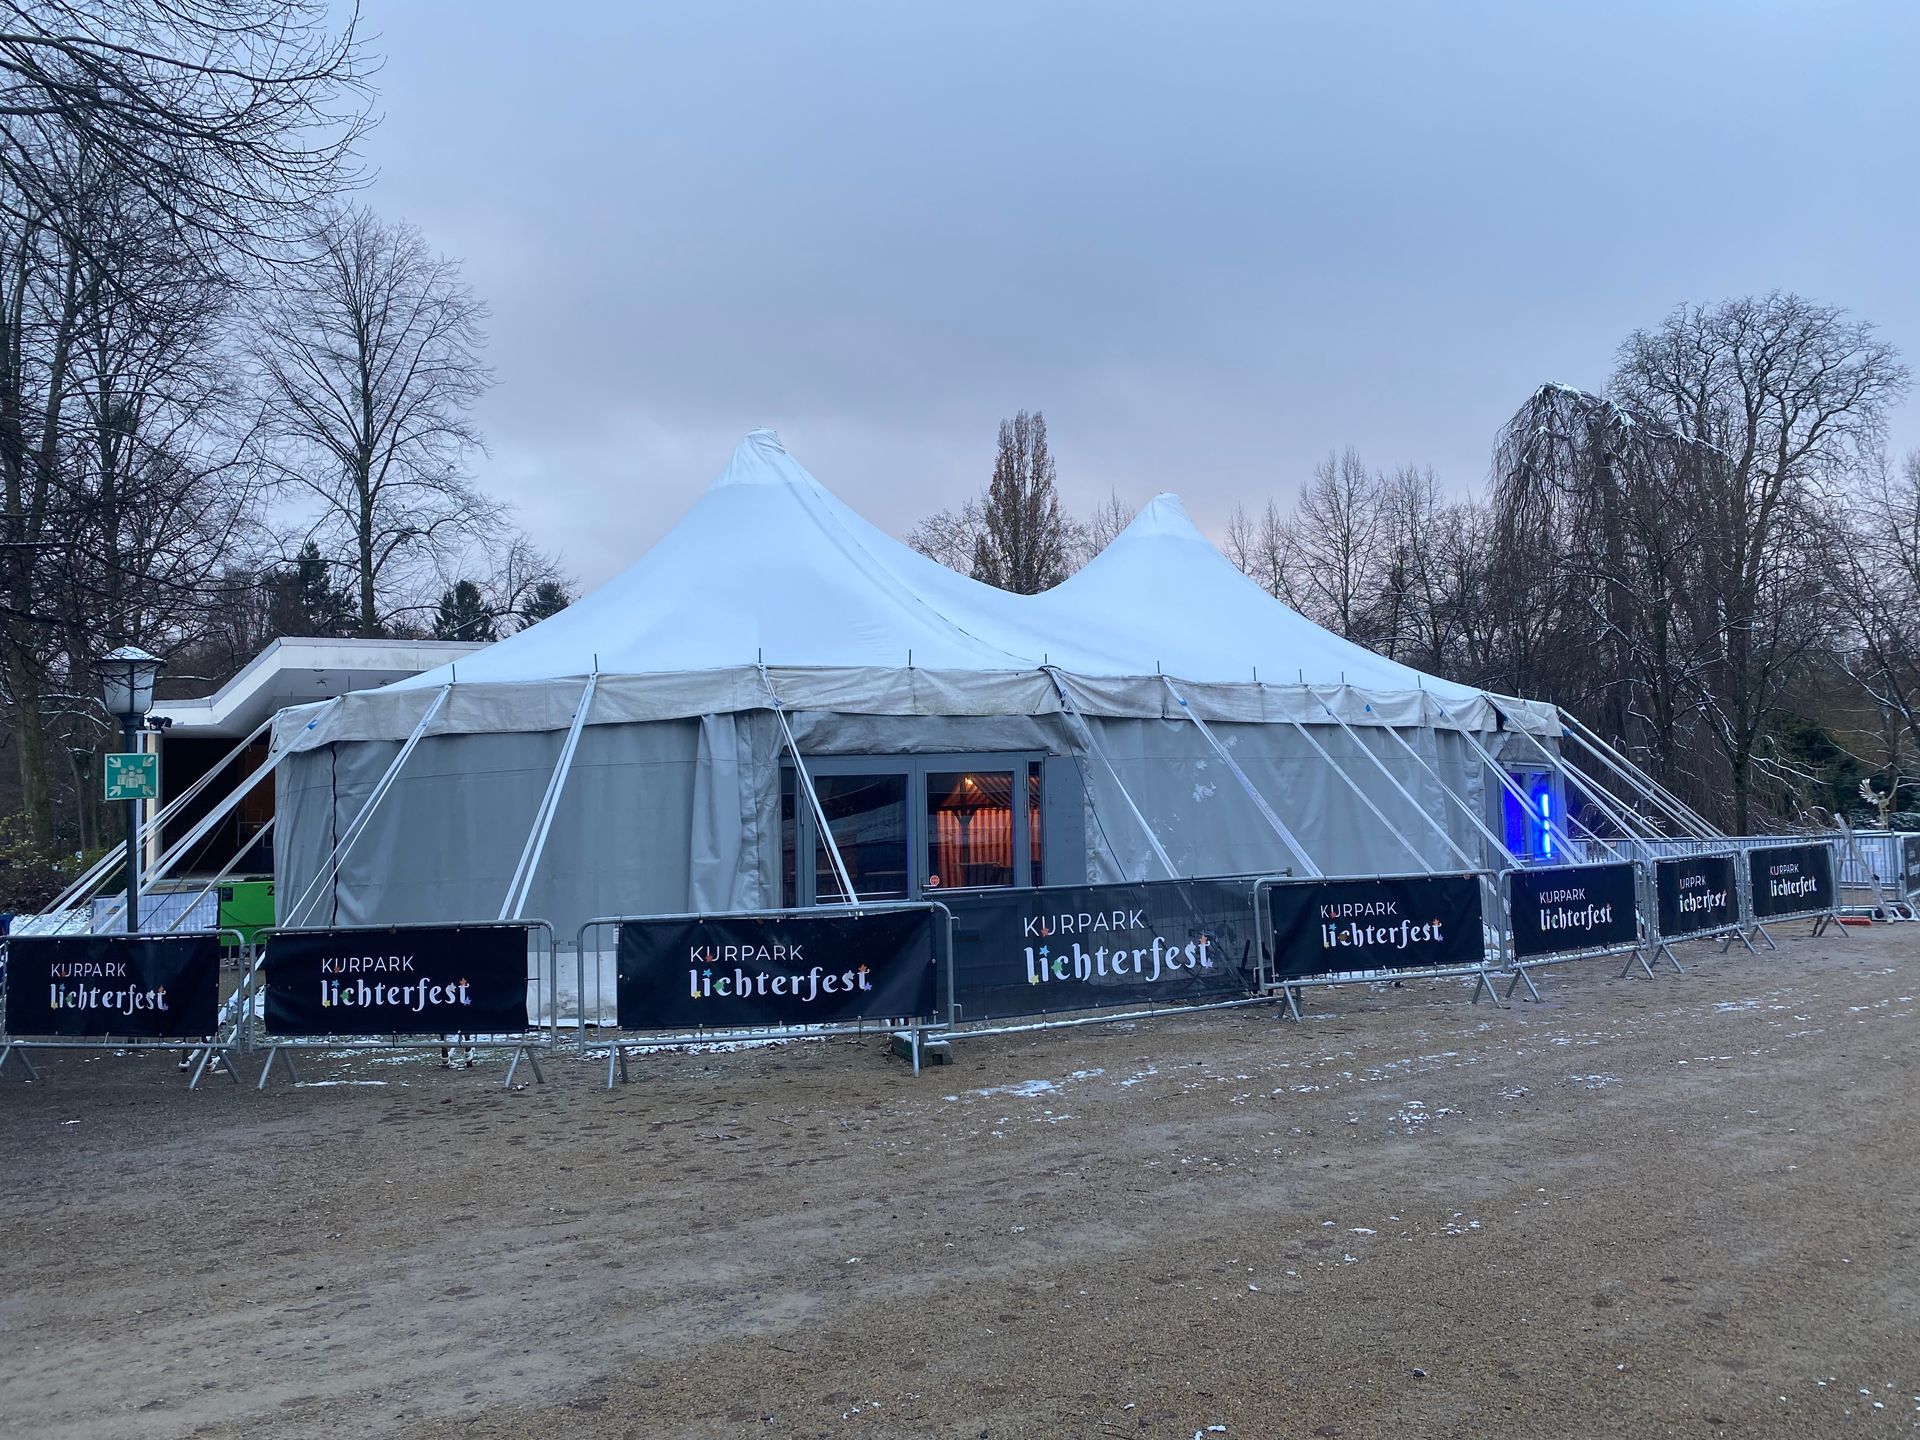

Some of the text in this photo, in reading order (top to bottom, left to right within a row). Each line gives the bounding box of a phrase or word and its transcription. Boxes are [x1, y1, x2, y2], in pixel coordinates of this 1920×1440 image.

[1320, 901, 1398, 919] KURPARK
[1539, 887, 1586, 904] KURPARK
[1024, 908, 1145, 937] KURPARK
[1539, 903, 1613, 932] lichterfest
[1321, 918, 1444, 949] lichterfest
[321, 955, 415, 974] KURPARK
[690, 944, 804, 963] KURPARK
[1023, 935, 1215, 986] lichterfest
[51, 962, 127, 978] KURPARK
[688, 963, 873, 1002] lichterfest
[50, 983, 169, 1016] lichterfest
[320, 977, 472, 1012] lichterfest
